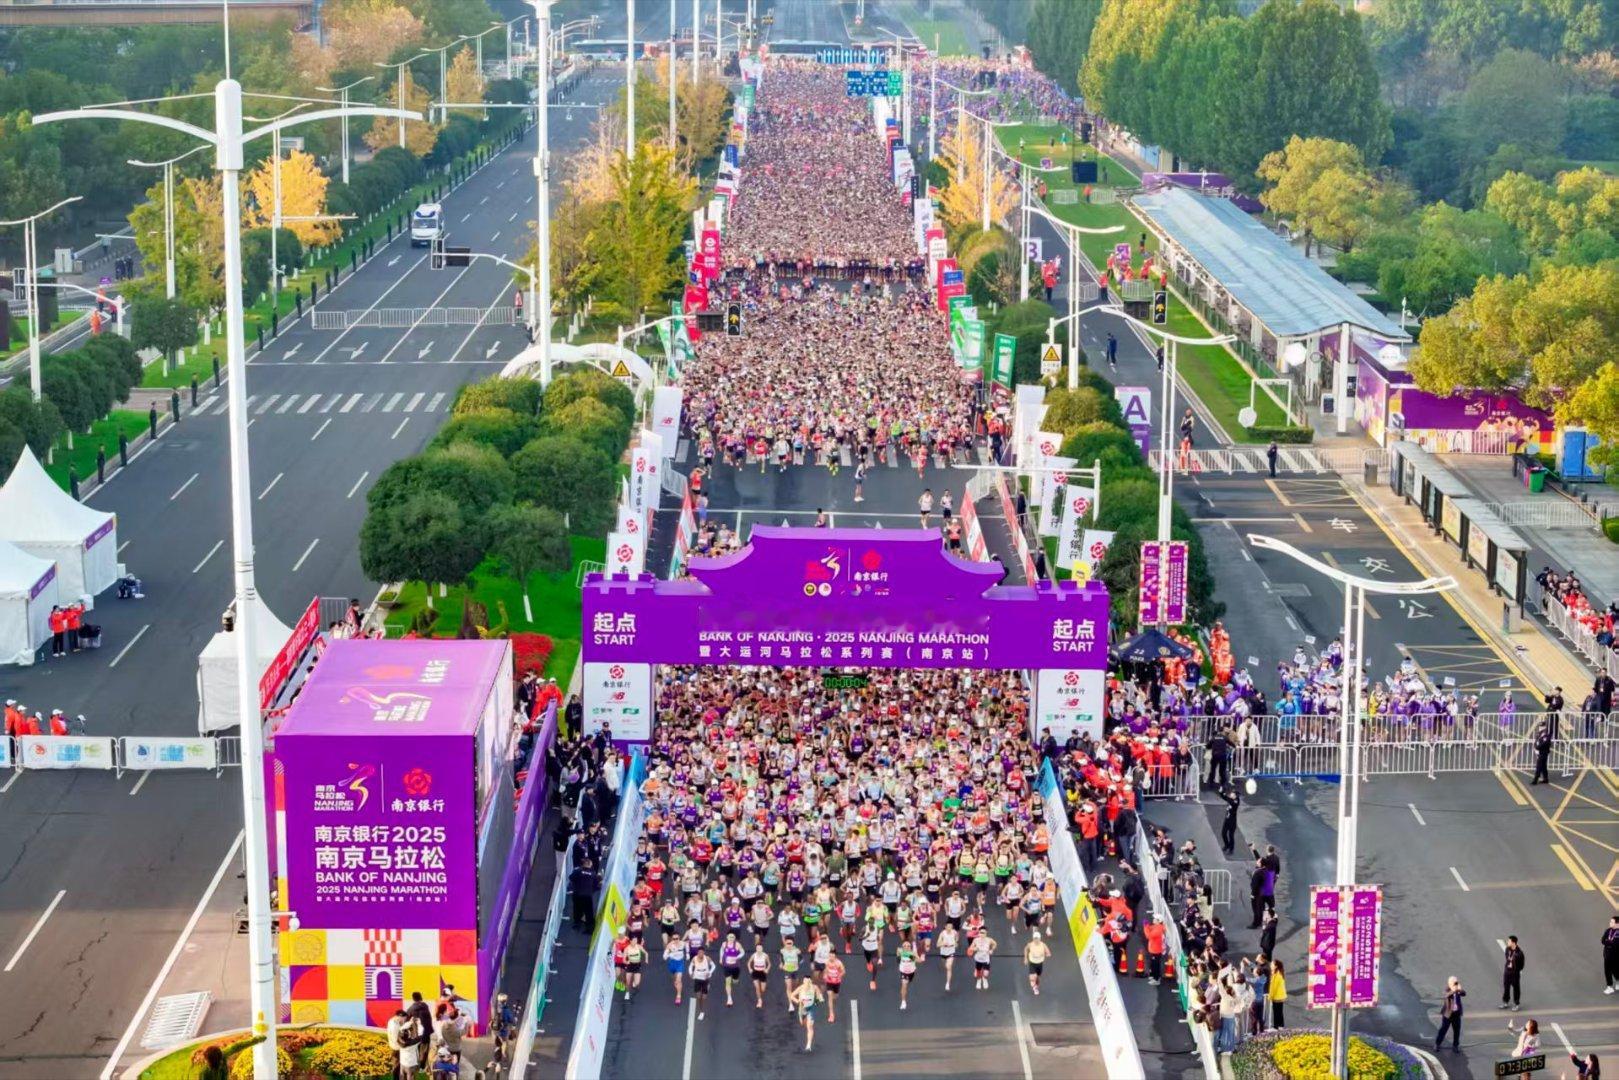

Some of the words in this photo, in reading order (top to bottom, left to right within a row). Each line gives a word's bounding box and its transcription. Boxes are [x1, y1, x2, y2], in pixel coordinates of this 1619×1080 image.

[1123, 395, 1147, 421] A
[593, 611, 637, 633] 起点
[1052, 618, 1096, 640] 起点
[594, 634, 636, 645] START
[699, 632, 733, 642] BANK
[737, 632, 754, 642] OF
[758, 632, 814, 643] NANJING
[825, 632, 855, 643] 2025
[858, 632, 915, 644] NANJING
[918, 633, 989, 645] MARATHON
[1052, 641, 1095, 653] START
[391, 798, 445, 812] 南京银行
[314, 825, 447, 843] 南京银行2025
[315, 845, 446, 870] 南京马拉松
[315, 872, 355, 883] BANK
[359, 872, 379, 883] OF
[383, 872, 447, 883] NANJING
[316, 885, 341, 894] 2025
[343, 885, 388, 894] NANJING
[390, 885, 448, 894] MARATHON
